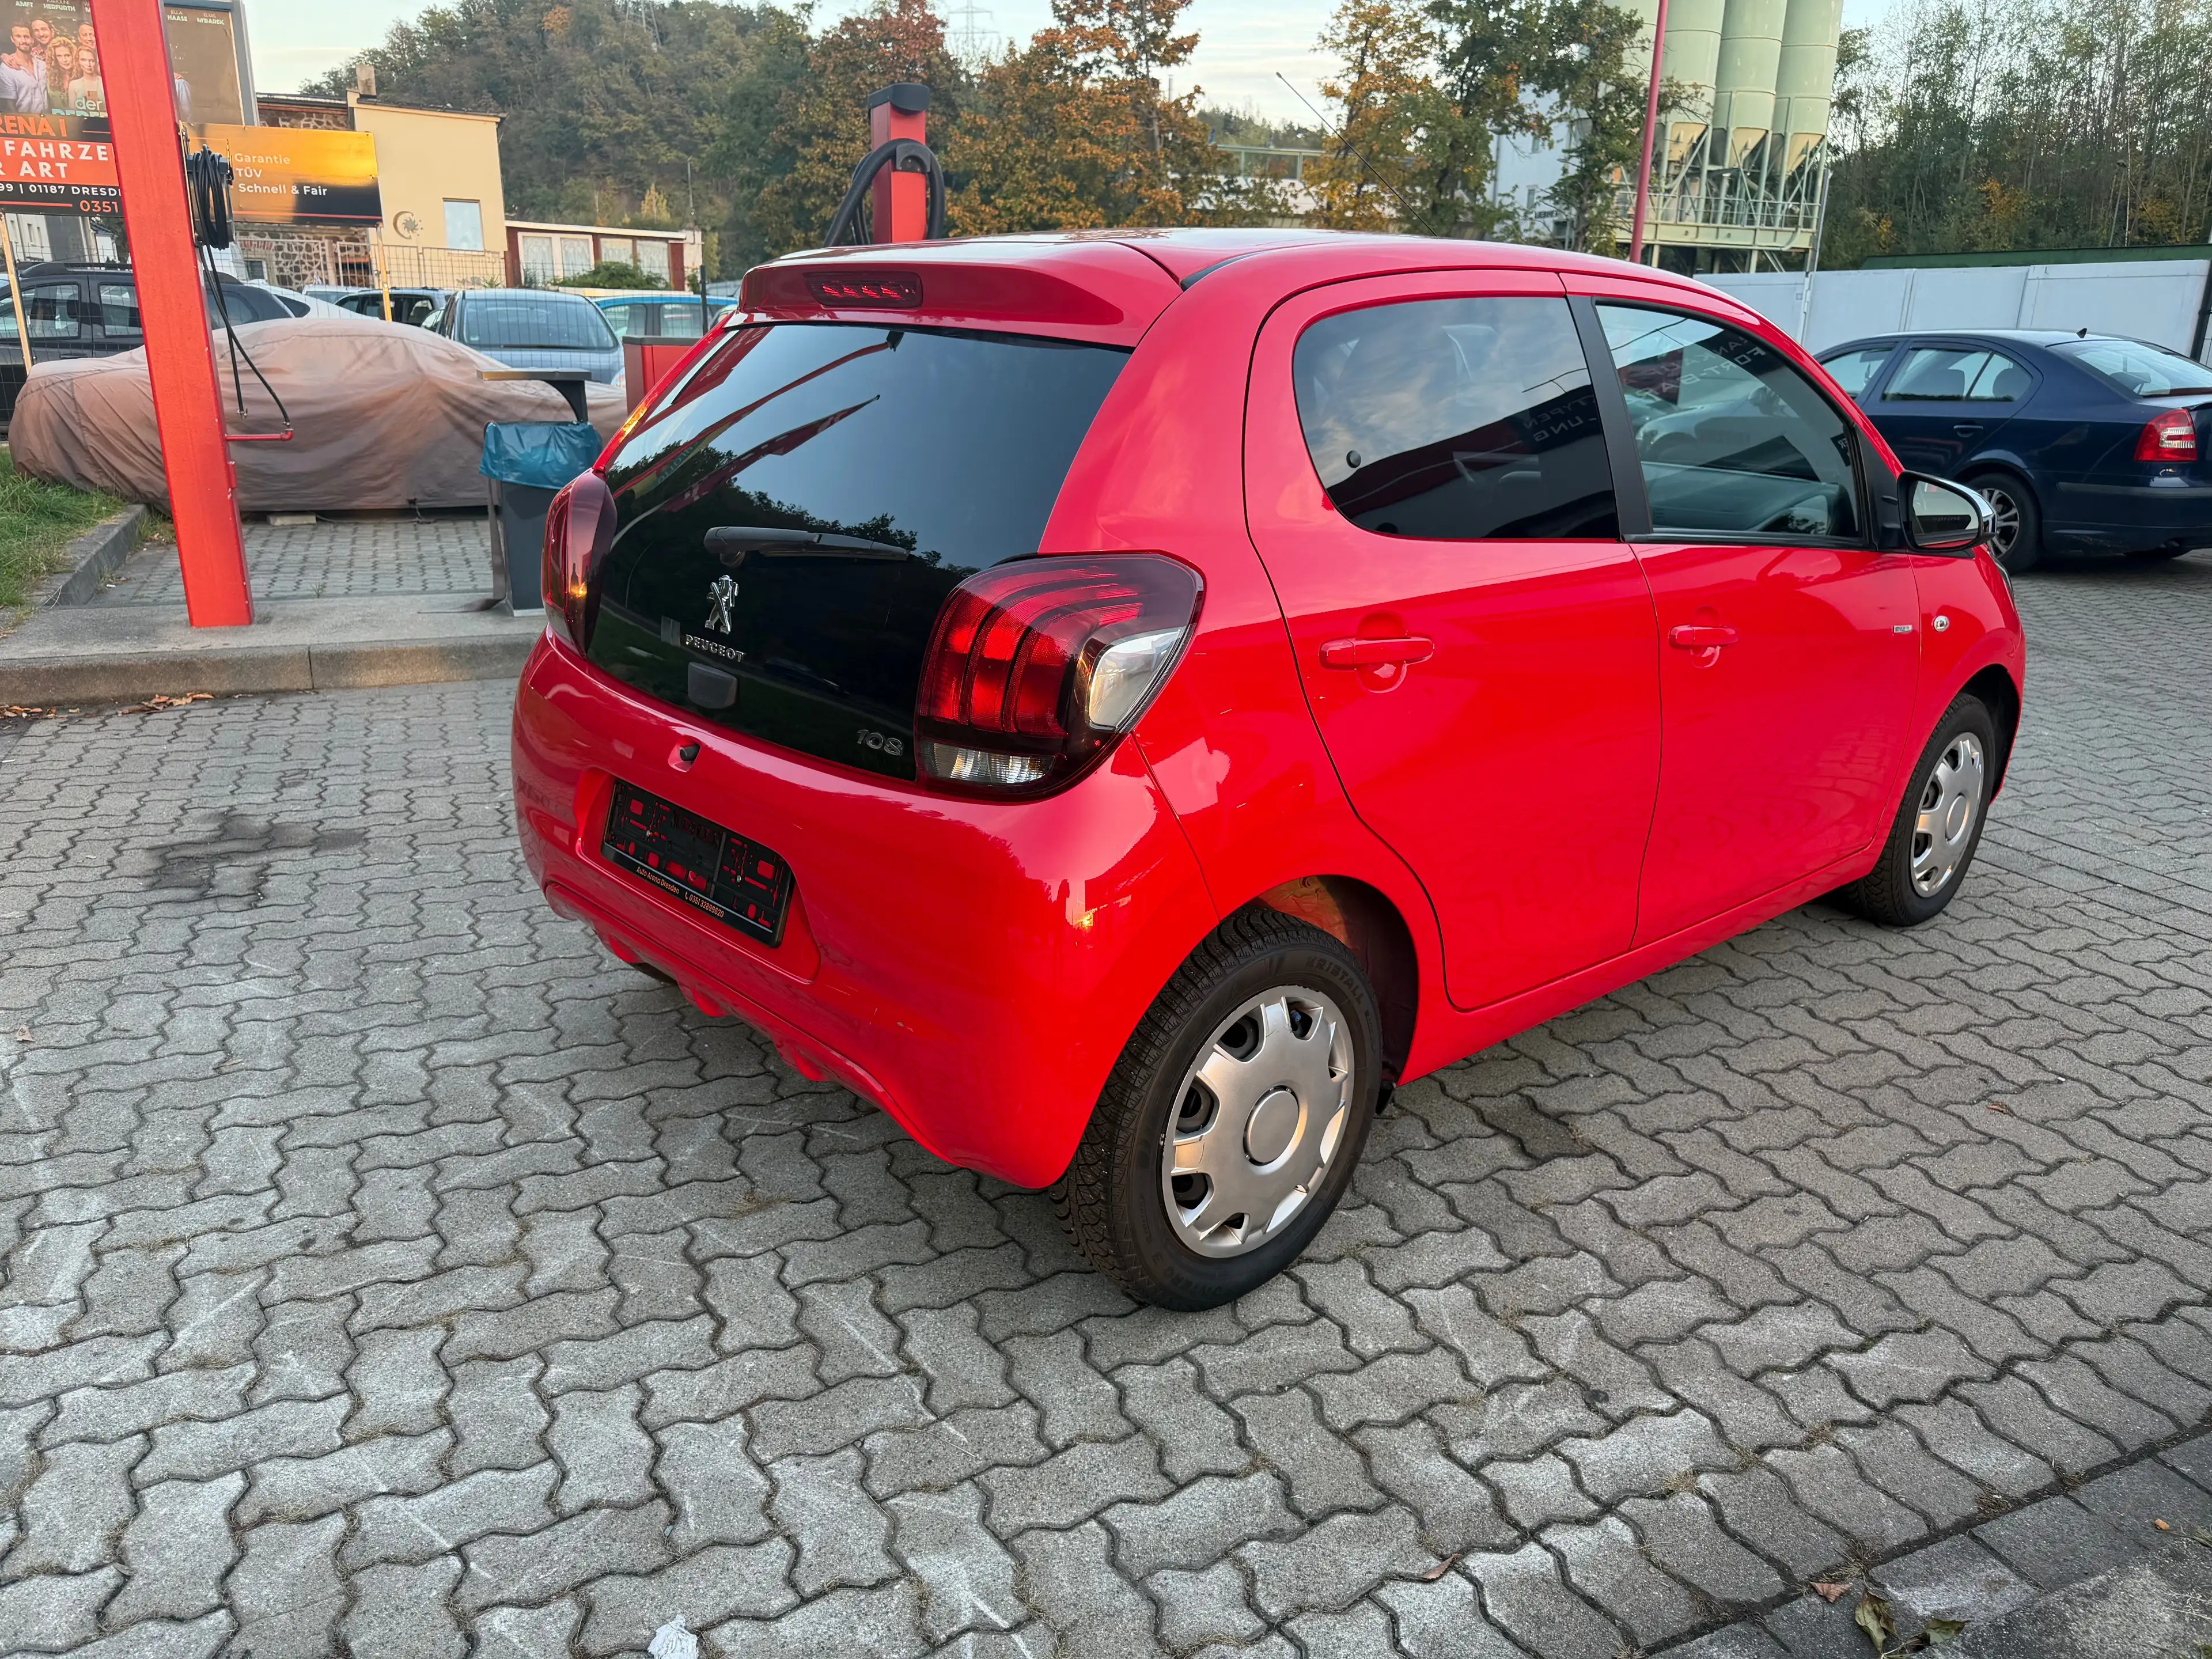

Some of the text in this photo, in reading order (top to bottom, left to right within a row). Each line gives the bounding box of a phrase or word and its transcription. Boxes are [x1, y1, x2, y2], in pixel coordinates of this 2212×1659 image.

[43, 3, 76, 12] HERFURTH
[75, 97, 103, 111] der
[4, 140, 108, 161] FAHRZE
[234, 153, 290, 164] Garantie
[20, 161, 68, 178] ART
[236, 166, 262, 178] TÜV
[29, 184, 65, 194] 01187
[238, 183, 327, 196] Schnell & Fair
[79, 200, 119, 213] 0351
[685, 634, 744, 662] PEUGEOT
[857, 729, 903, 756] 108
[636, 866, 647, 876] Auto
[660, 879, 680, 894] Dresden
[689, 894, 700, 906] 0351
